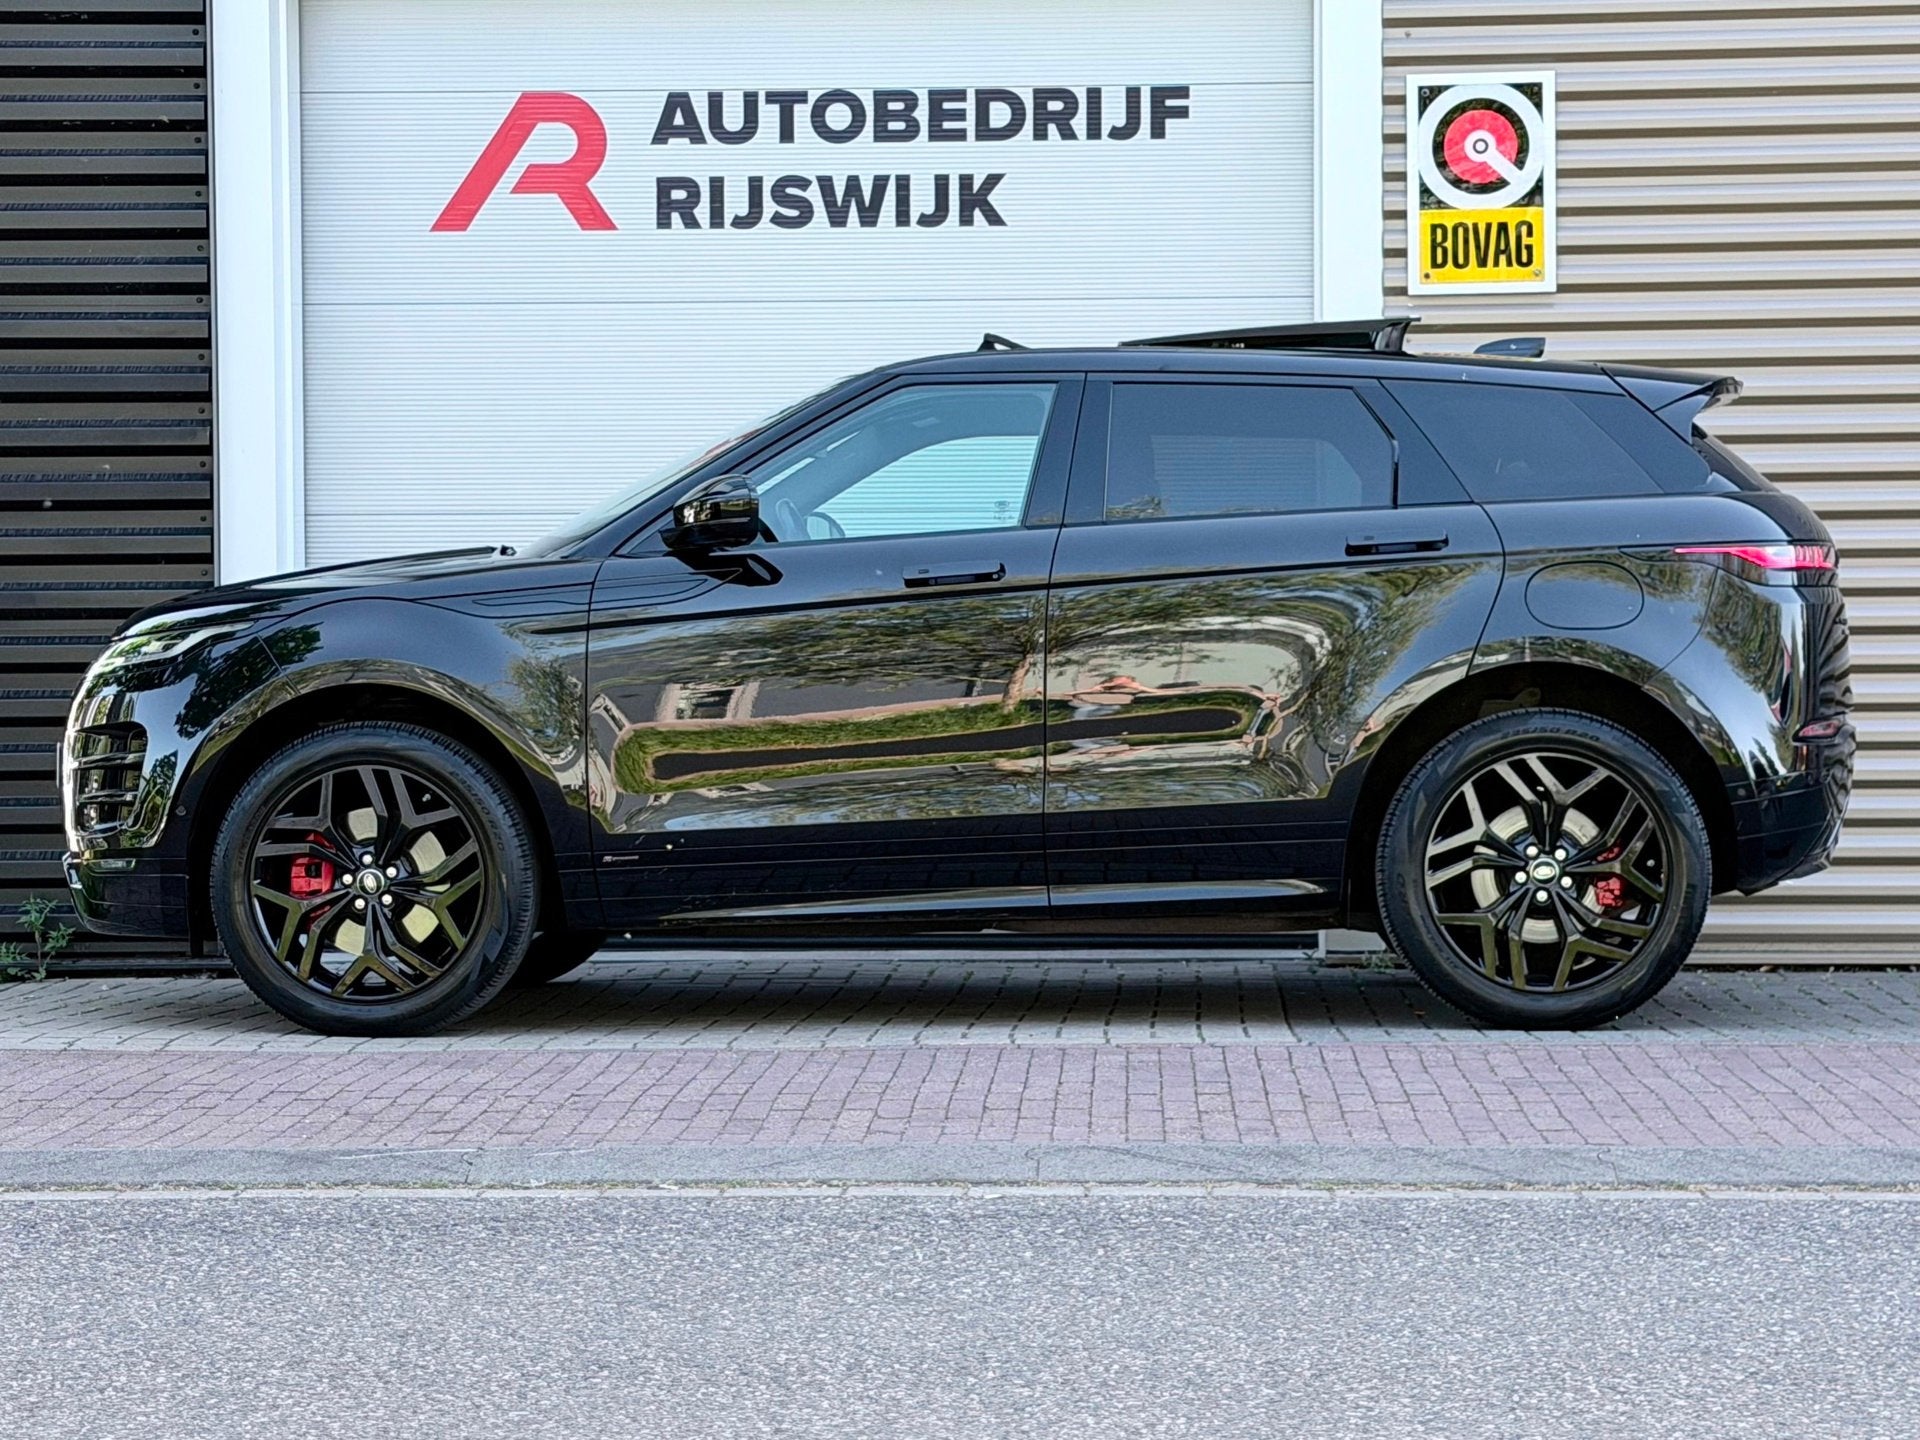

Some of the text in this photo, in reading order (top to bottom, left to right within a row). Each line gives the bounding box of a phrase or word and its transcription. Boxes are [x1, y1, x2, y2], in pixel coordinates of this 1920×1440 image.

[651, 86, 1190, 144] AUTOBEDRIJF
[657, 174, 1007, 229] RIJSWIJK
[1430, 221, 1534, 270] BOVAG
